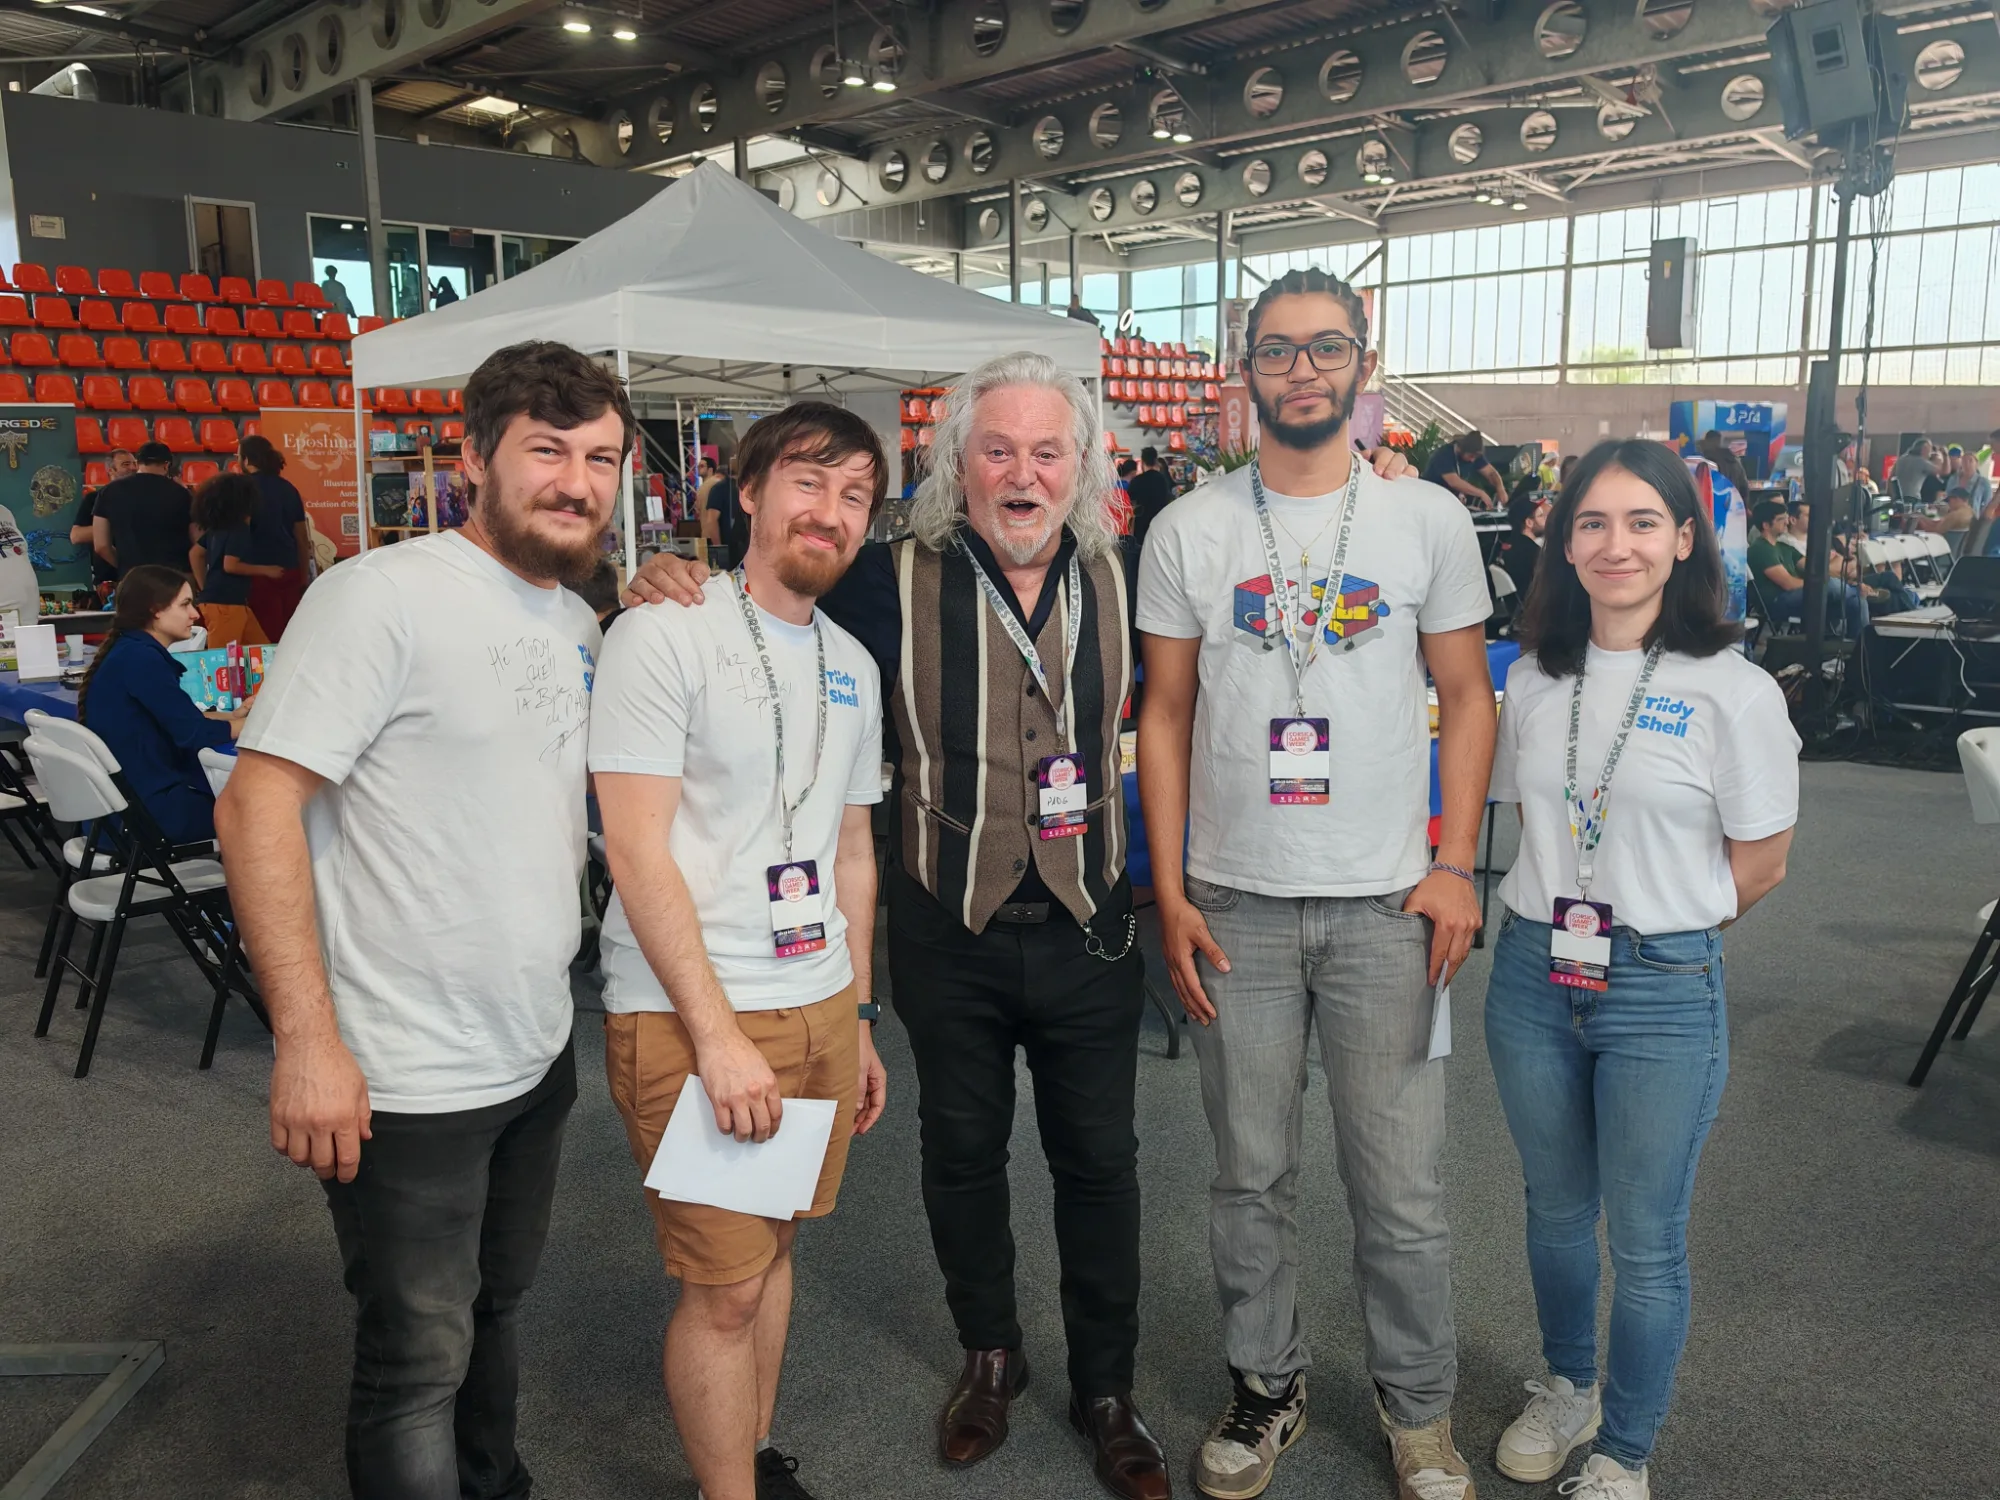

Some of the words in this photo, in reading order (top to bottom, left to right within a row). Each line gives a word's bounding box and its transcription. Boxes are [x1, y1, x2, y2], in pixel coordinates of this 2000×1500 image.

[1738, 411, 1760, 424] PS4
[1251, 476, 1268, 509] WEEK
[1343, 475, 1359, 523] CORSICA
[1259, 508, 1276, 550] GAMES
[1334, 524, 1350, 568] GAMES
[1269, 551, 1288, 603] CORSICA
[1325, 567, 1342, 609] WEEK
[981, 579, 1010, 619] GAMES
[1006, 618, 1032, 651] WEEK
[1069, 594, 1079, 642] CORSICA
[741, 601, 767, 652] CORSICA
[760, 654, 779, 700] GAMES
[772, 702, 784, 741] WEEK
[817, 655, 827, 697] GAMES
[826, 669, 857, 691] Tiidy
[828, 689, 860, 708] Shell
[1601, 732, 1629, 783] CORSICA
[1621, 686, 1647, 730] GAMES
[1639, 650, 1661, 683] WEEK
[1644, 696, 1695, 720] Tiidy
[819, 701, 828, 750] CORSICA
[1568, 700, 1581, 743] GAMES
[1636, 714, 1688, 738] Shell
[1566, 744, 1577, 782] WEEK
